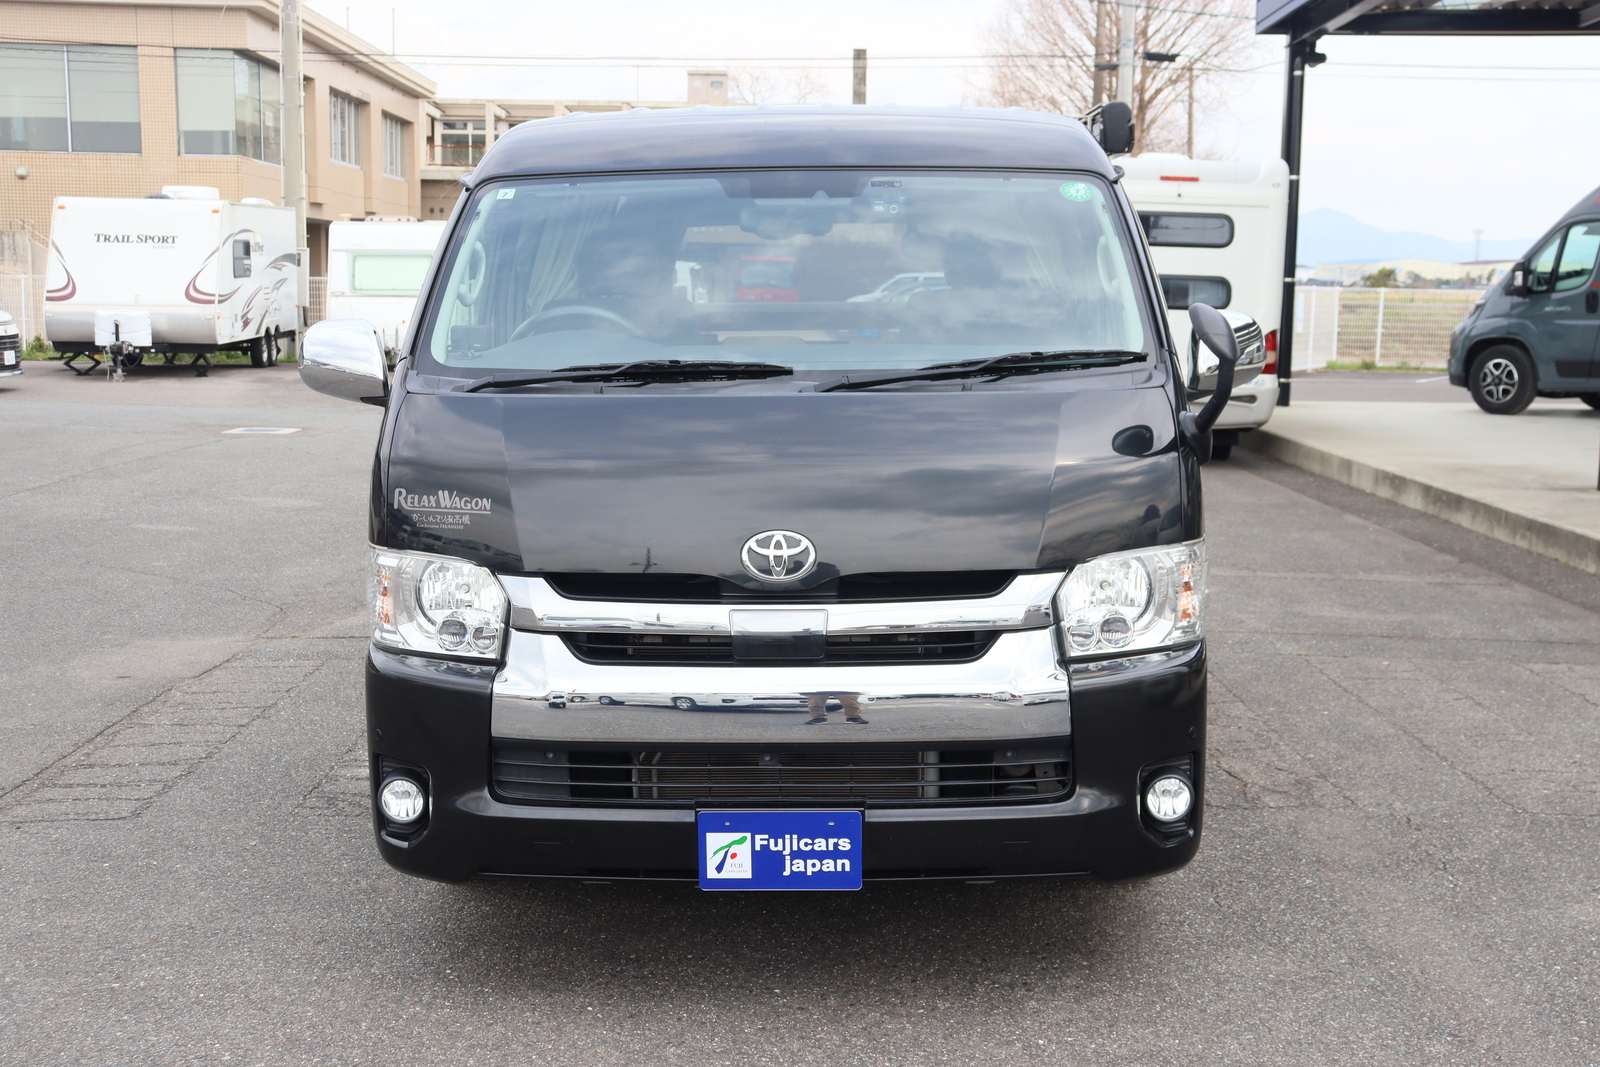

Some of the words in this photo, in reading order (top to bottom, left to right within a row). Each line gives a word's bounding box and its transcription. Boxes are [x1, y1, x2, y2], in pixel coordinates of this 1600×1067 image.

[94, 233, 135, 243] TRAIL
[136, 234, 178, 244] SPORT
[393, 488, 437, 509] RELAX
[438, 490, 491, 510] WAGON
[754, 834, 851, 855] Fujicars
[783, 855, 850, 876] japan
